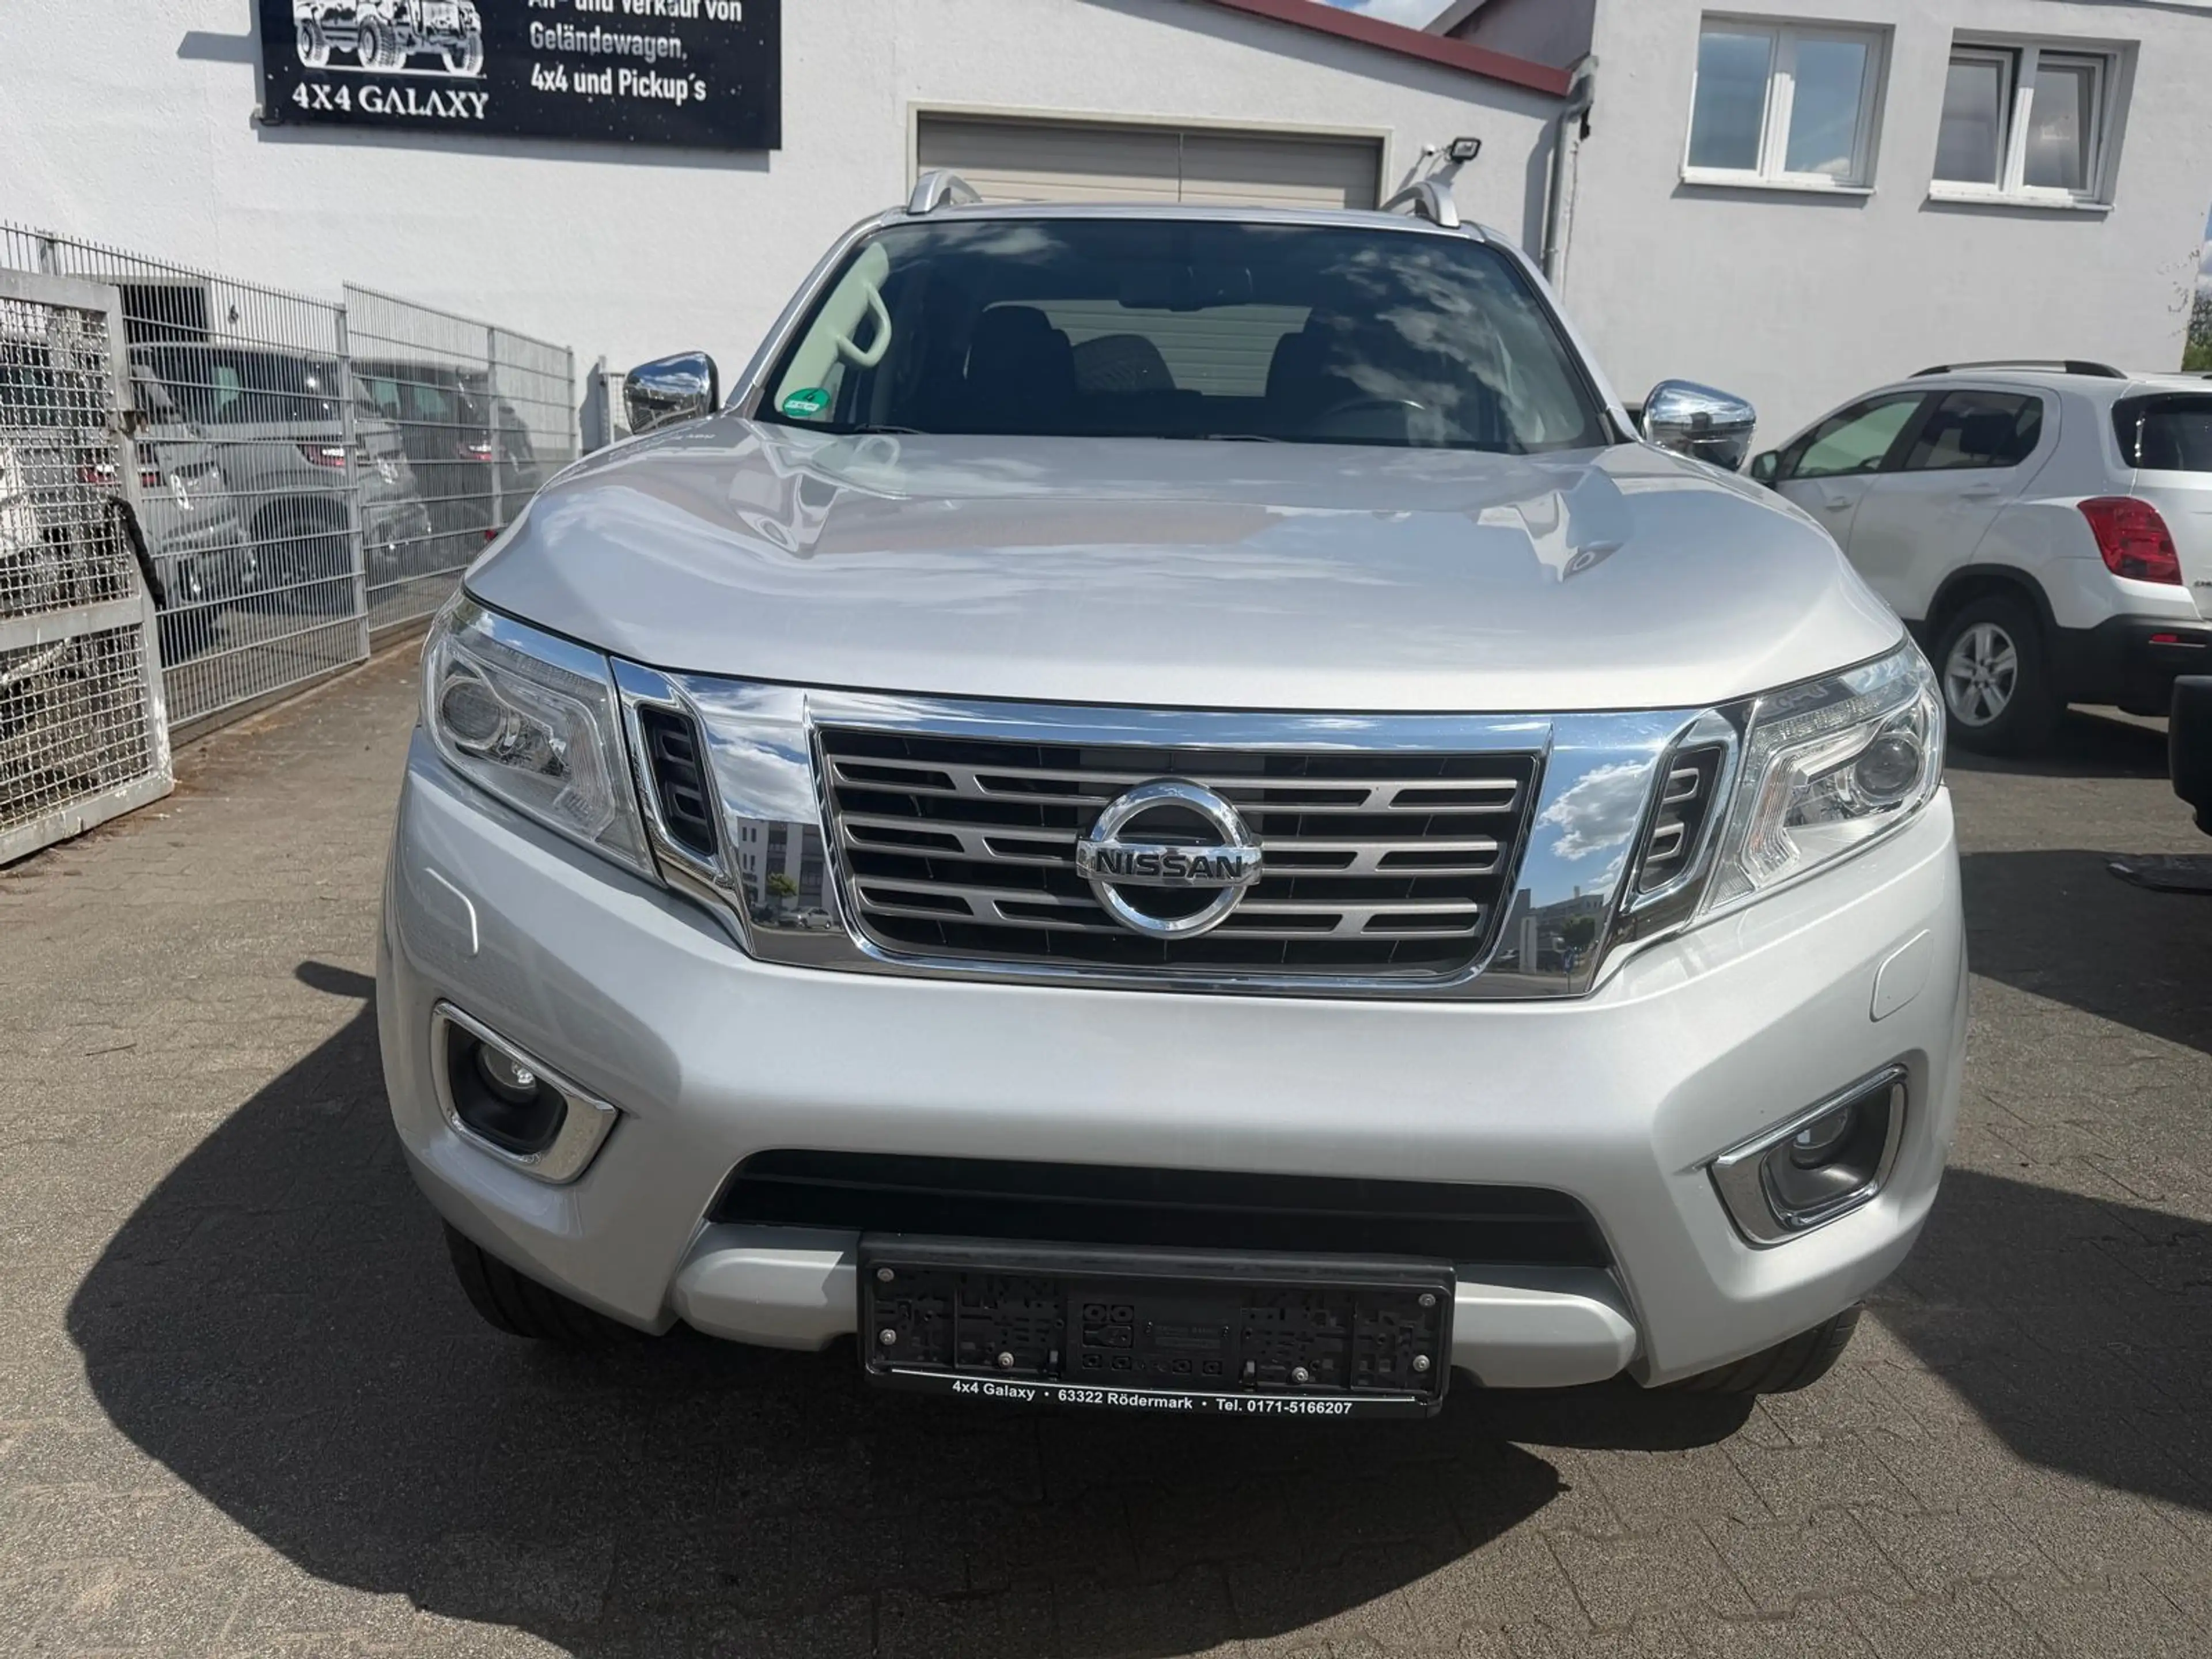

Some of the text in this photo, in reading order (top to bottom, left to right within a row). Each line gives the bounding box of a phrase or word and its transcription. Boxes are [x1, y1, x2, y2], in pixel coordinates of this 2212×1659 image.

[704, 0, 743, 22] von
[529, 21, 687, 63] Geländewagen,
[531, 62, 569, 92] 4x4
[574, 67, 612, 95] und
[292, 82, 489, 119] 4X4 GALAXY
[1096, 850, 1243, 878] NISSAN
[952, 1380, 1352, 1414] 4x4 Galaxy 63322 Rödermark Tel. 0171-5166207
